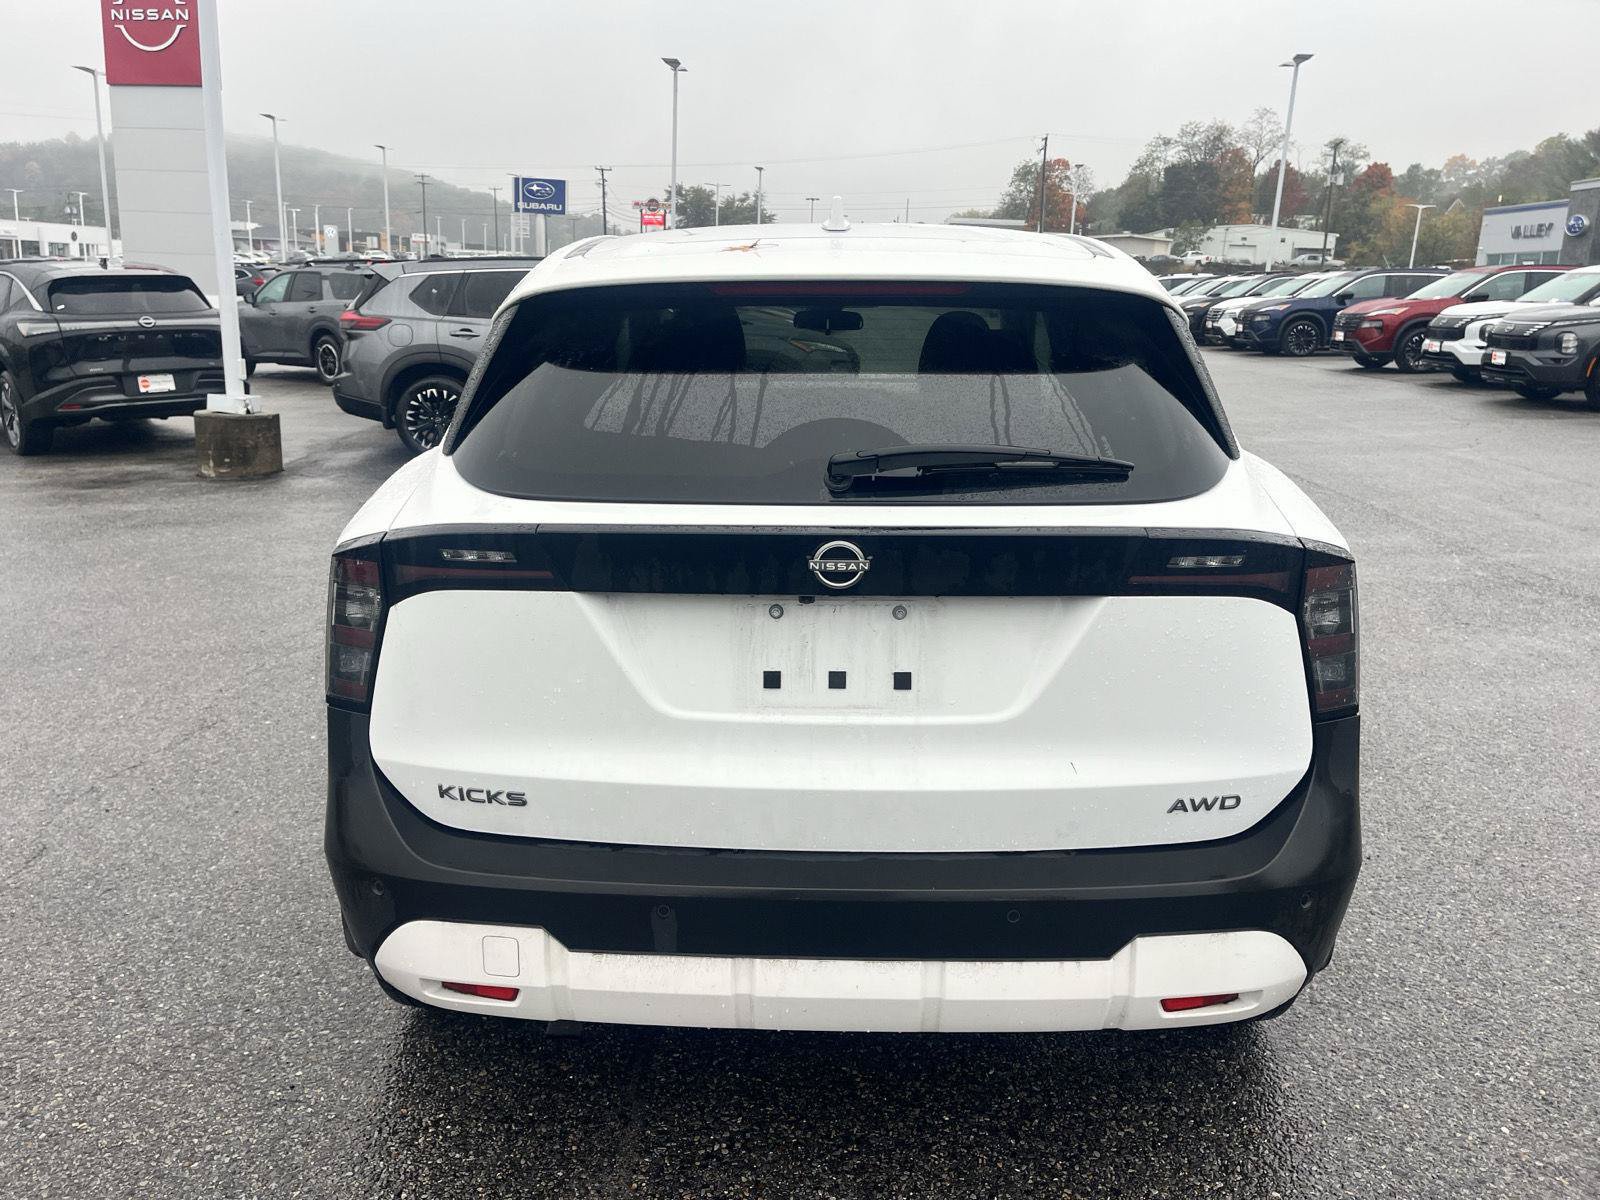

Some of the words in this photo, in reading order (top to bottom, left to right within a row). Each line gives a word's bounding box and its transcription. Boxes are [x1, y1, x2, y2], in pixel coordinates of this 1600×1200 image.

[110, 8, 189, 21] NISSAN
[517, 201, 563, 211] SUBARU
[809, 562, 869, 571] NISSAN
[437, 783, 528, 807] KICKS
[1166, 794, 1242, 814] AWD
